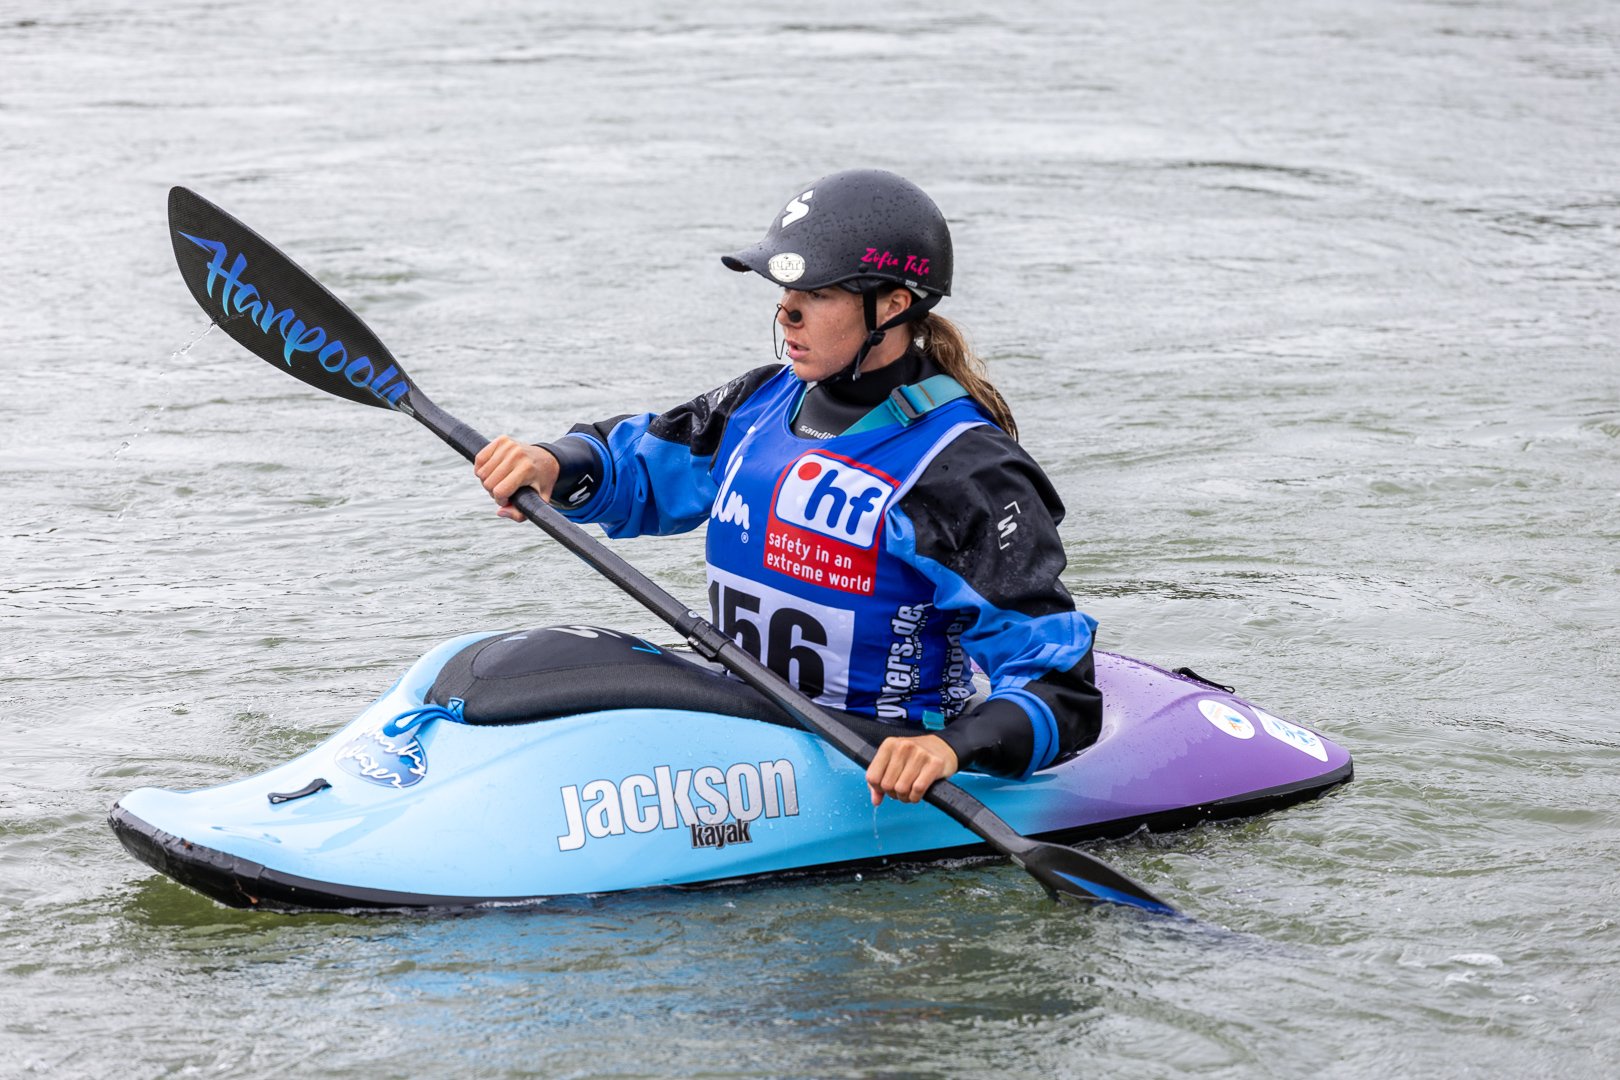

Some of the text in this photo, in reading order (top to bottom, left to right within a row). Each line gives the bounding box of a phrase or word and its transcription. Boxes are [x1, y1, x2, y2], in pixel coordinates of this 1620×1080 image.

[860, 247, 899, 270] Zofia
[768, 532, 852, 569] safety in an
[766, 552, 871, 592] extreme world
[691, 818, 753, 850] kayak
